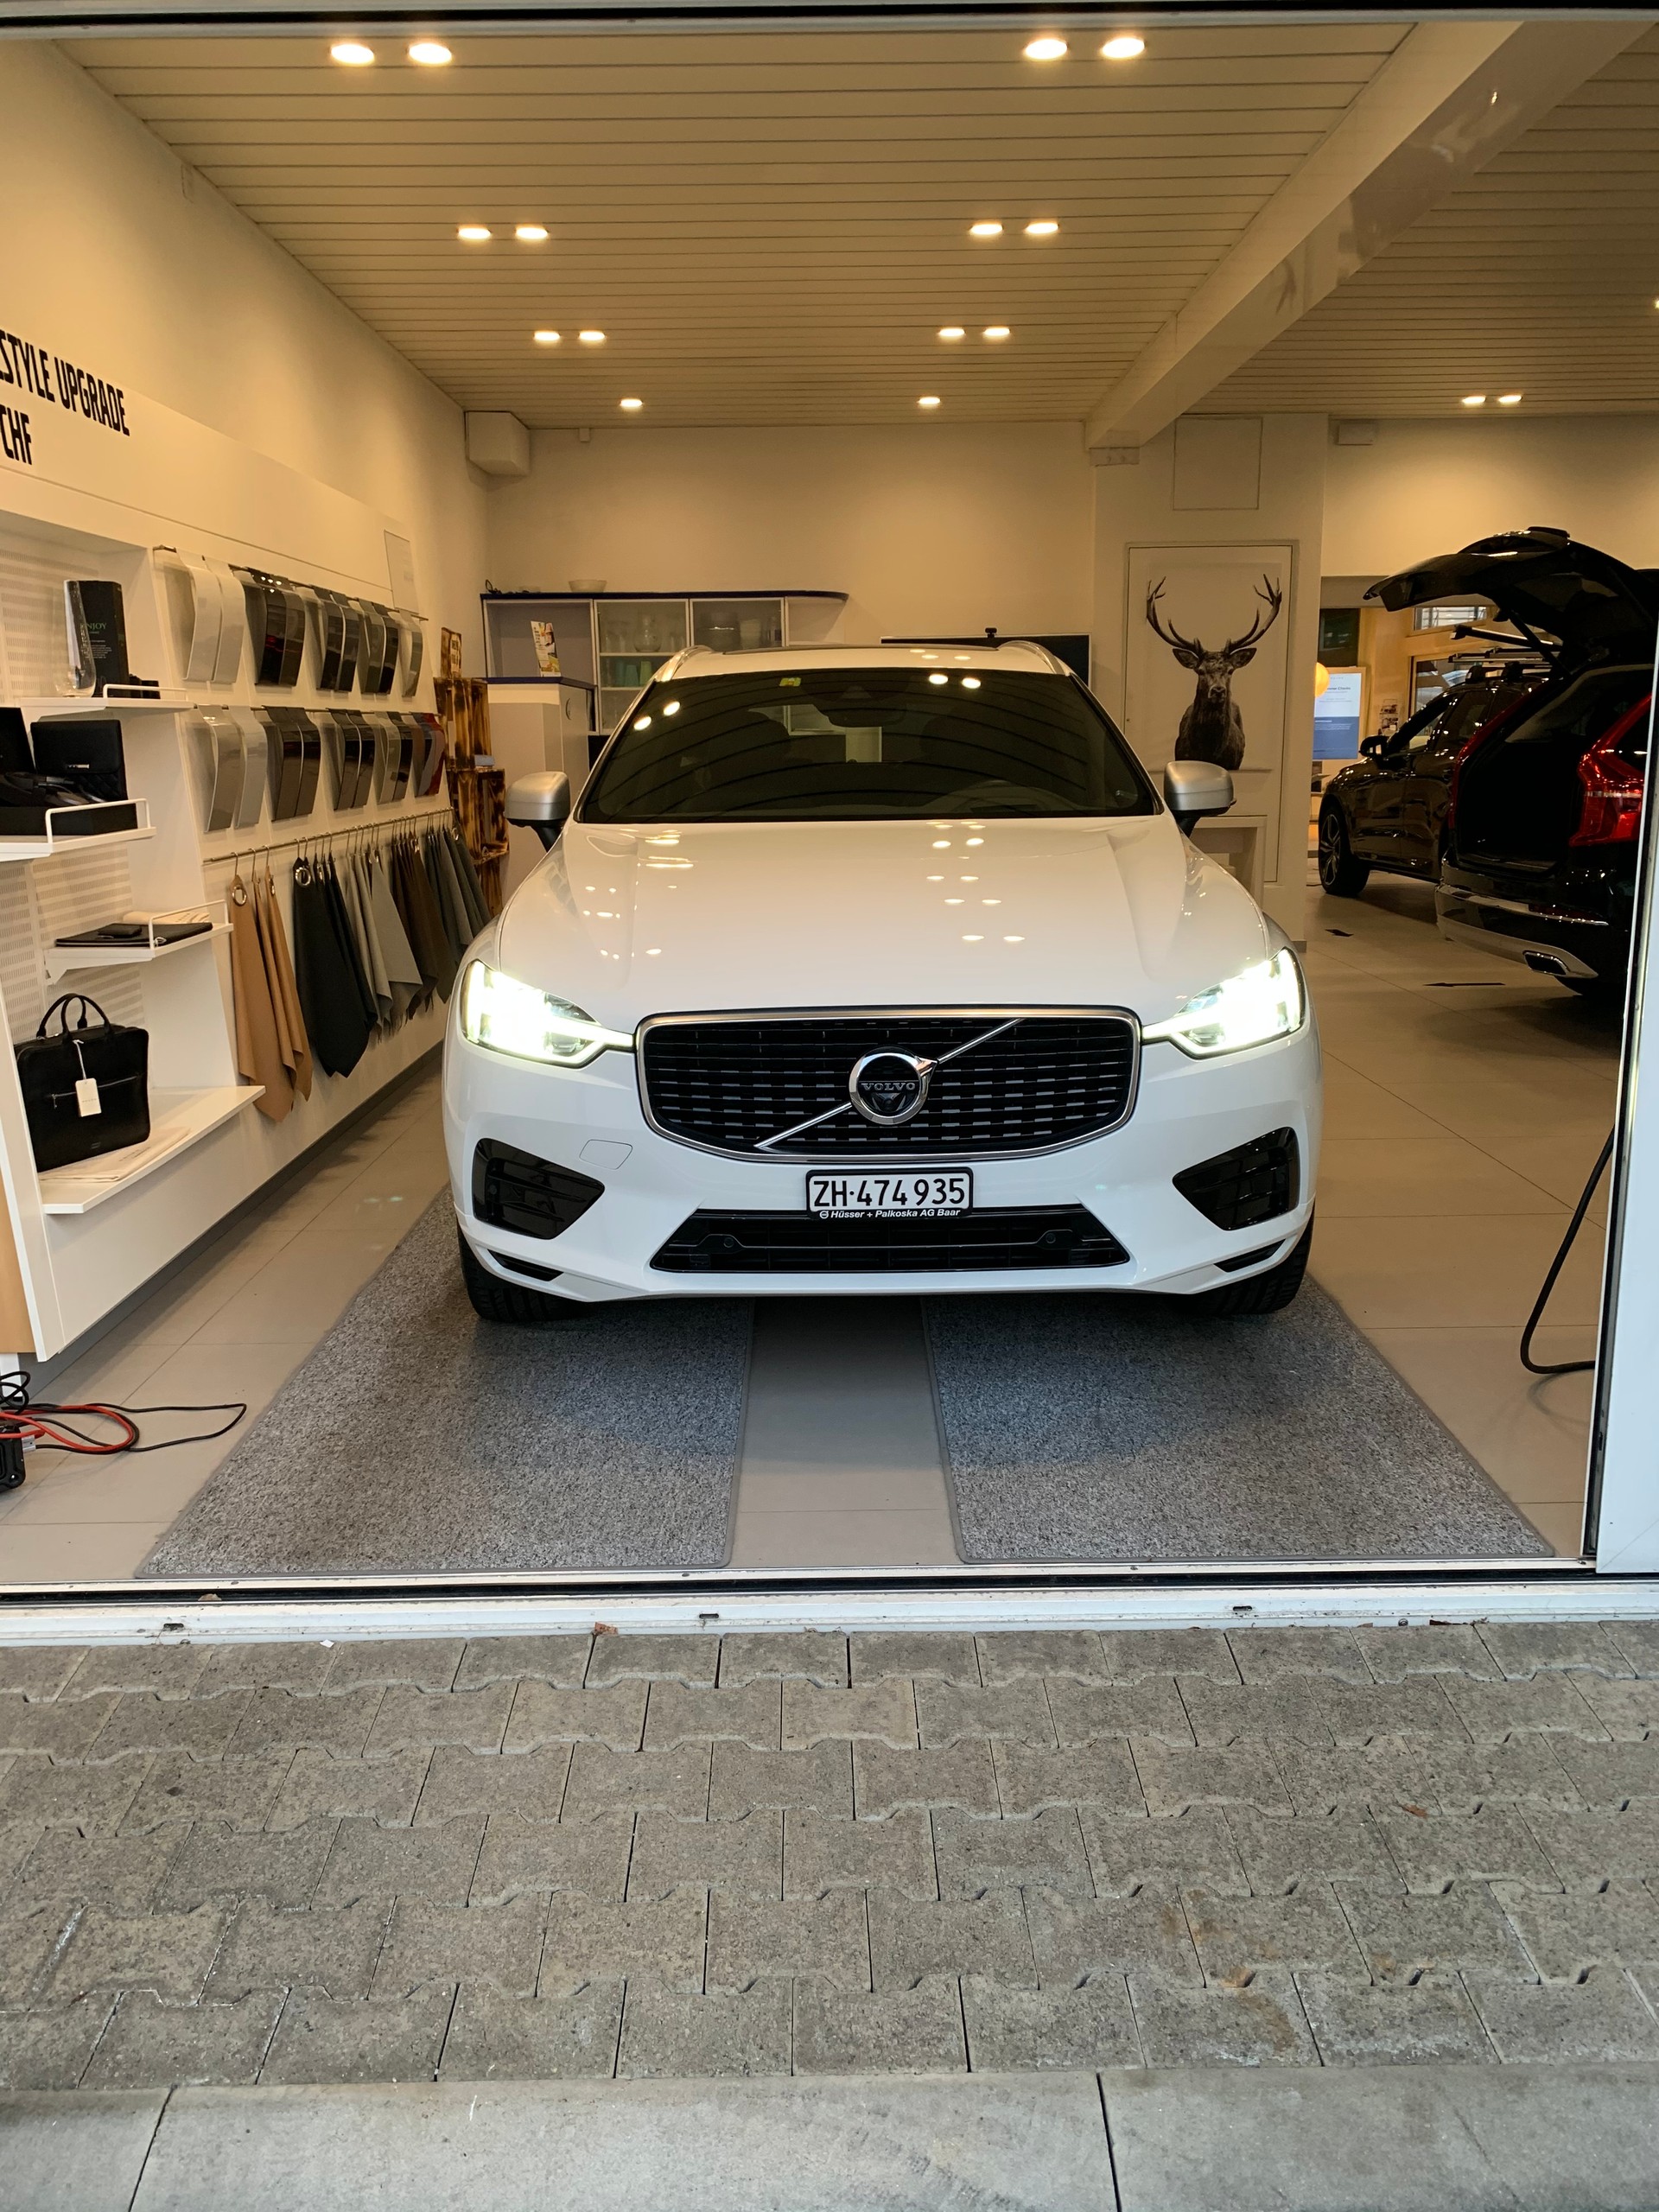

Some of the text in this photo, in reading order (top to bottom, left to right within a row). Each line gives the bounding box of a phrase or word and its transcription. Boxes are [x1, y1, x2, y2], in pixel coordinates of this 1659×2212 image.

[0, 328, 130, 436] STYLE UPGRADE
[0, 404, 32, 465] CHF
[861, 1082, 916, 1091] VOLVO
[830, 1210, 866, 1218] Hüsser
[937, 1208, 961, 1217] Baar
